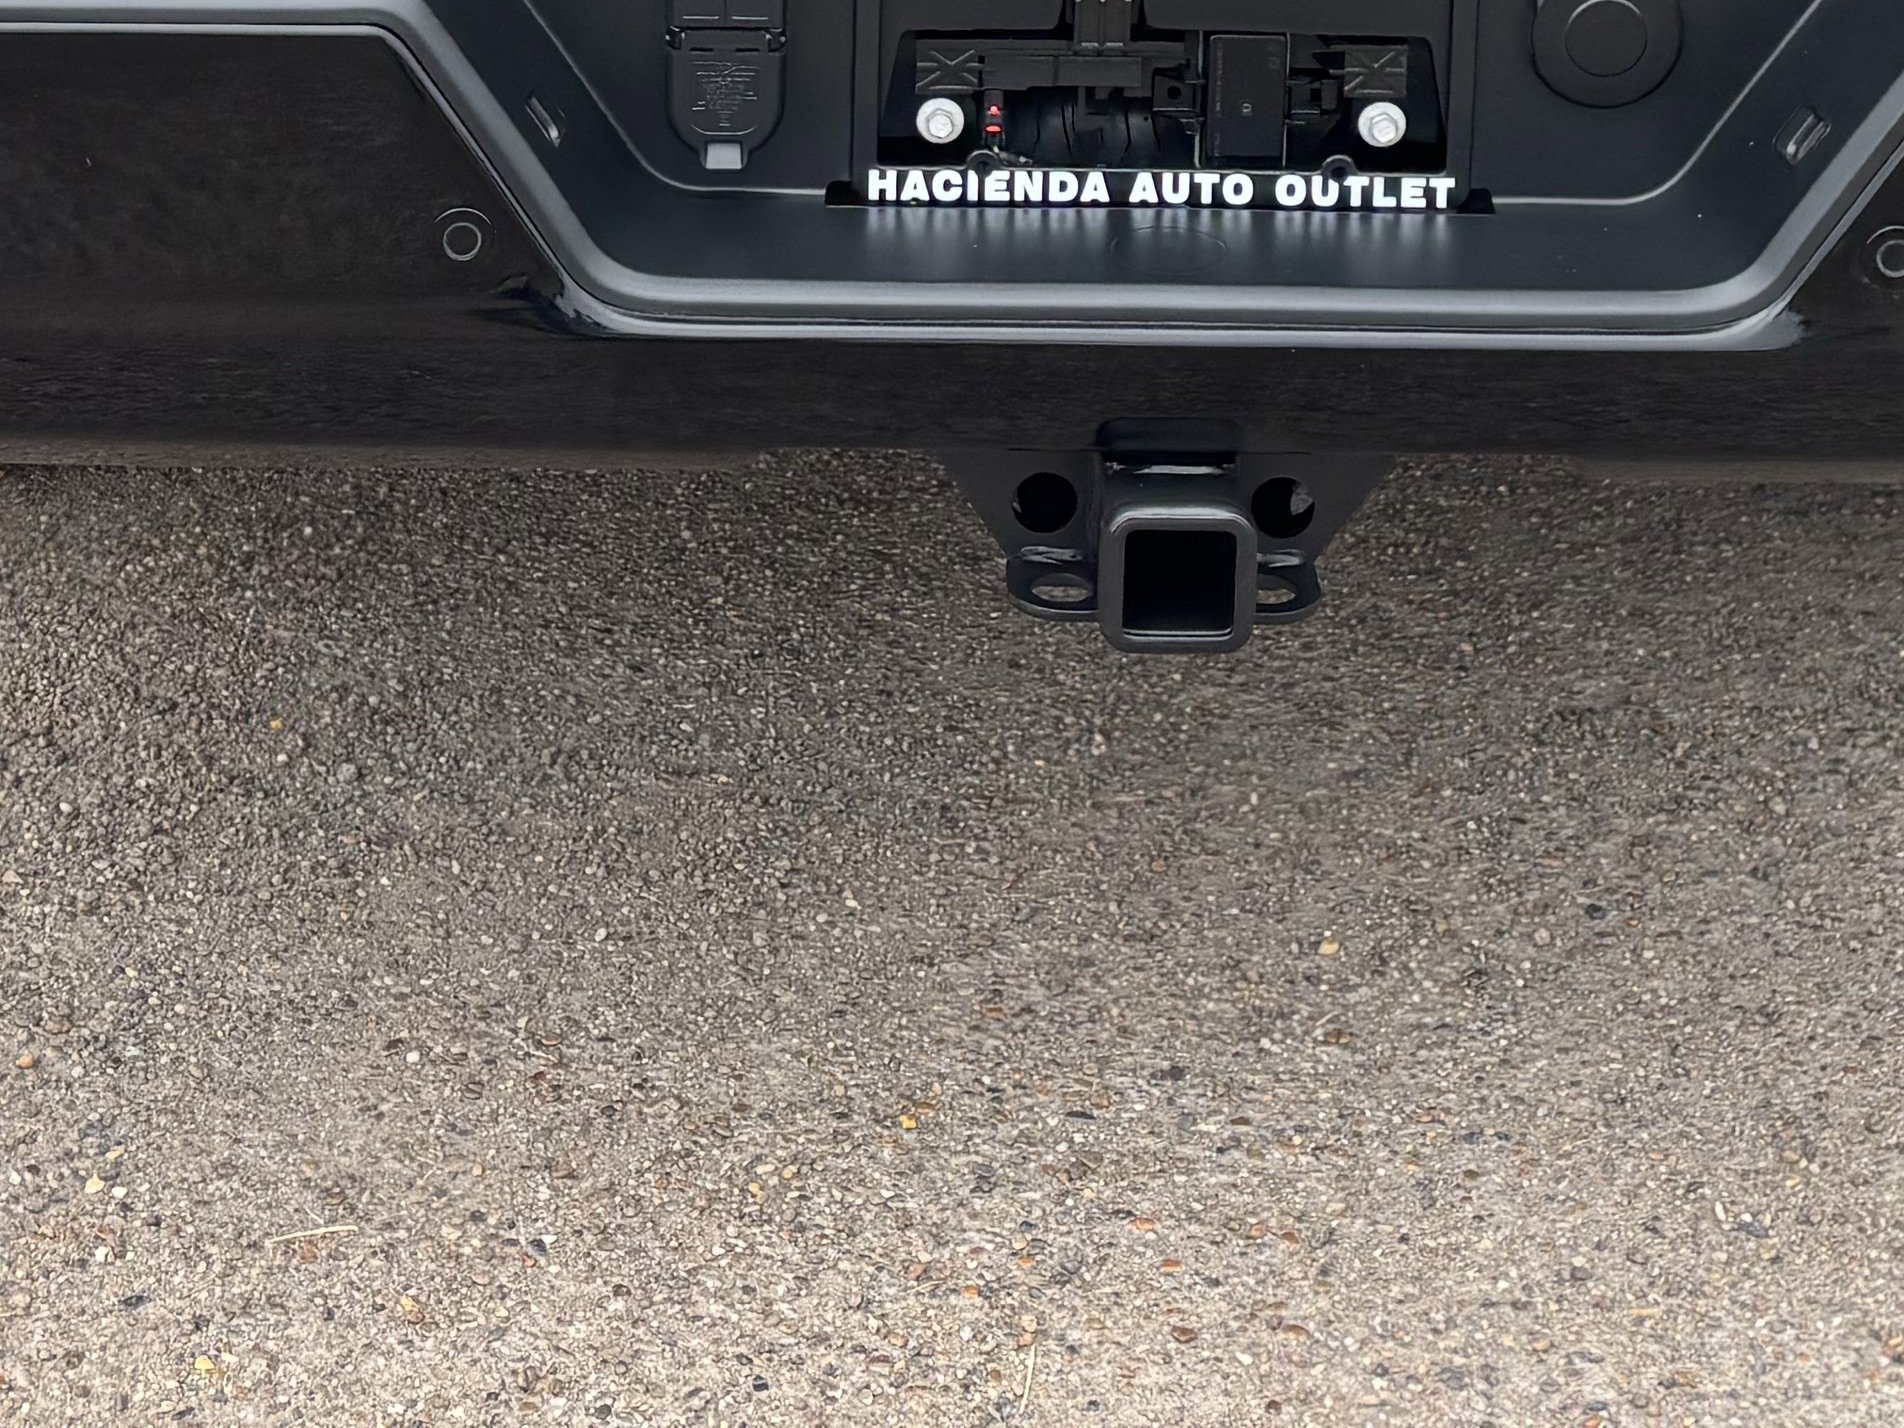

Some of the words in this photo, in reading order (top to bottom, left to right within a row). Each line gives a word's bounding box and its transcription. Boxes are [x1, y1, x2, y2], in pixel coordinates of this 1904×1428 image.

[867, 169, 1111, 204] HACIENDA
[1127, 171, 1255, 206] AUTO
[1274, 175, 1457, 210] OUTLET
